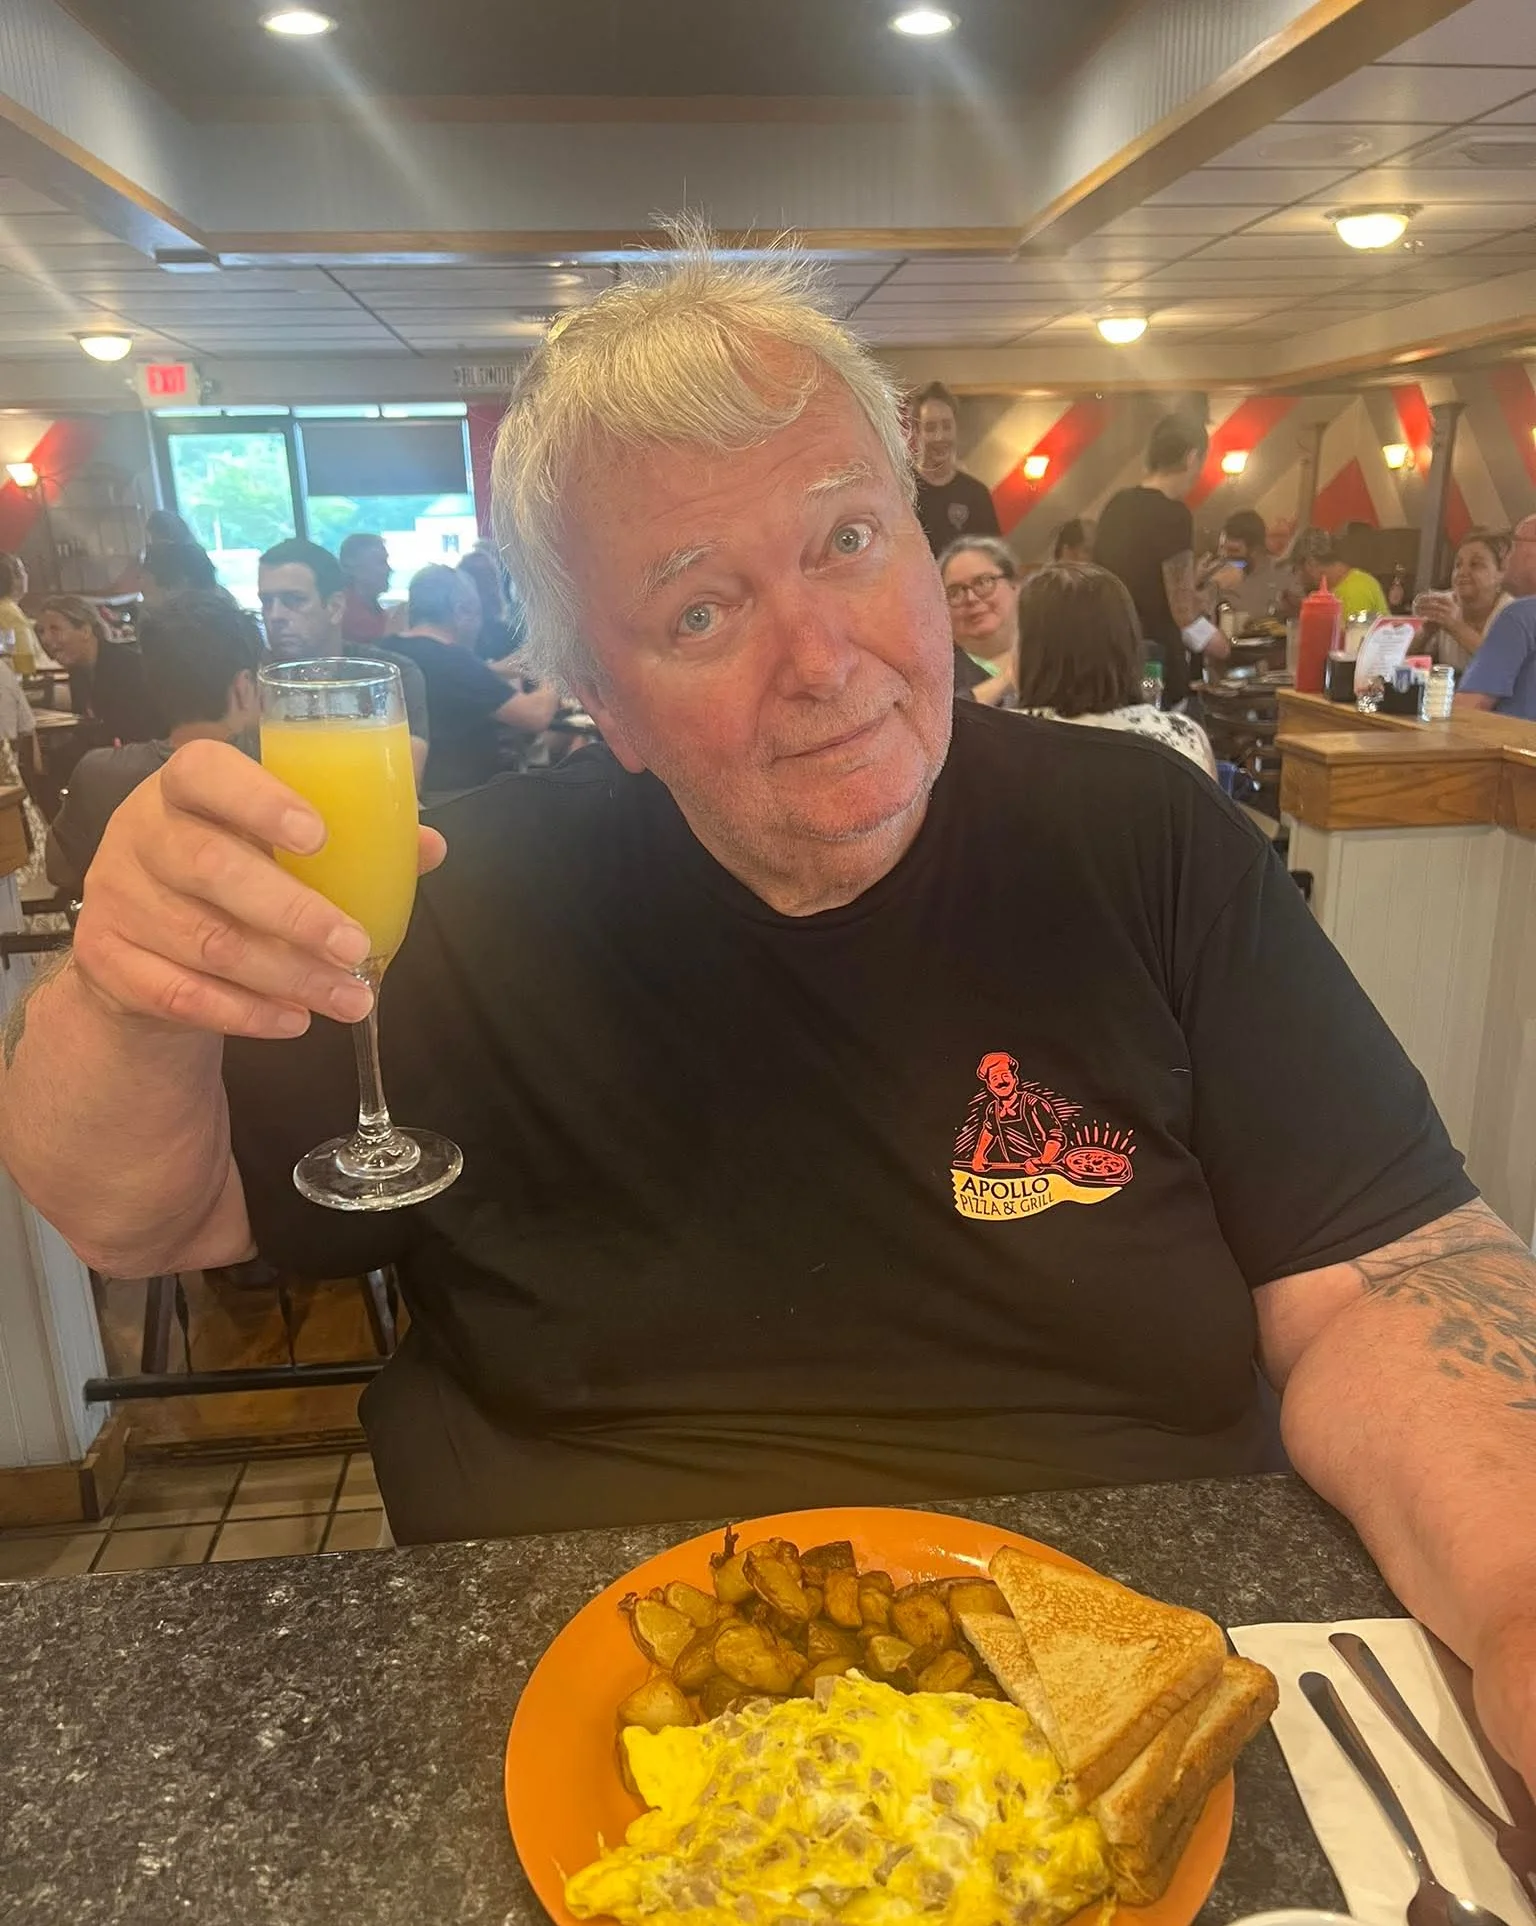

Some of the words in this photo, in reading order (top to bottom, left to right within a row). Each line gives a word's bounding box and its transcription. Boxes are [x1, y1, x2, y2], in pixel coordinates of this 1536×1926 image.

[960, 1176, 1050, 1199] APOLLO
[960, 1193, 1001, 1216] PIZZA
[1003, 1201, 1017, 1215] &
[1020, 1192, 1055, 1212] GRILL
